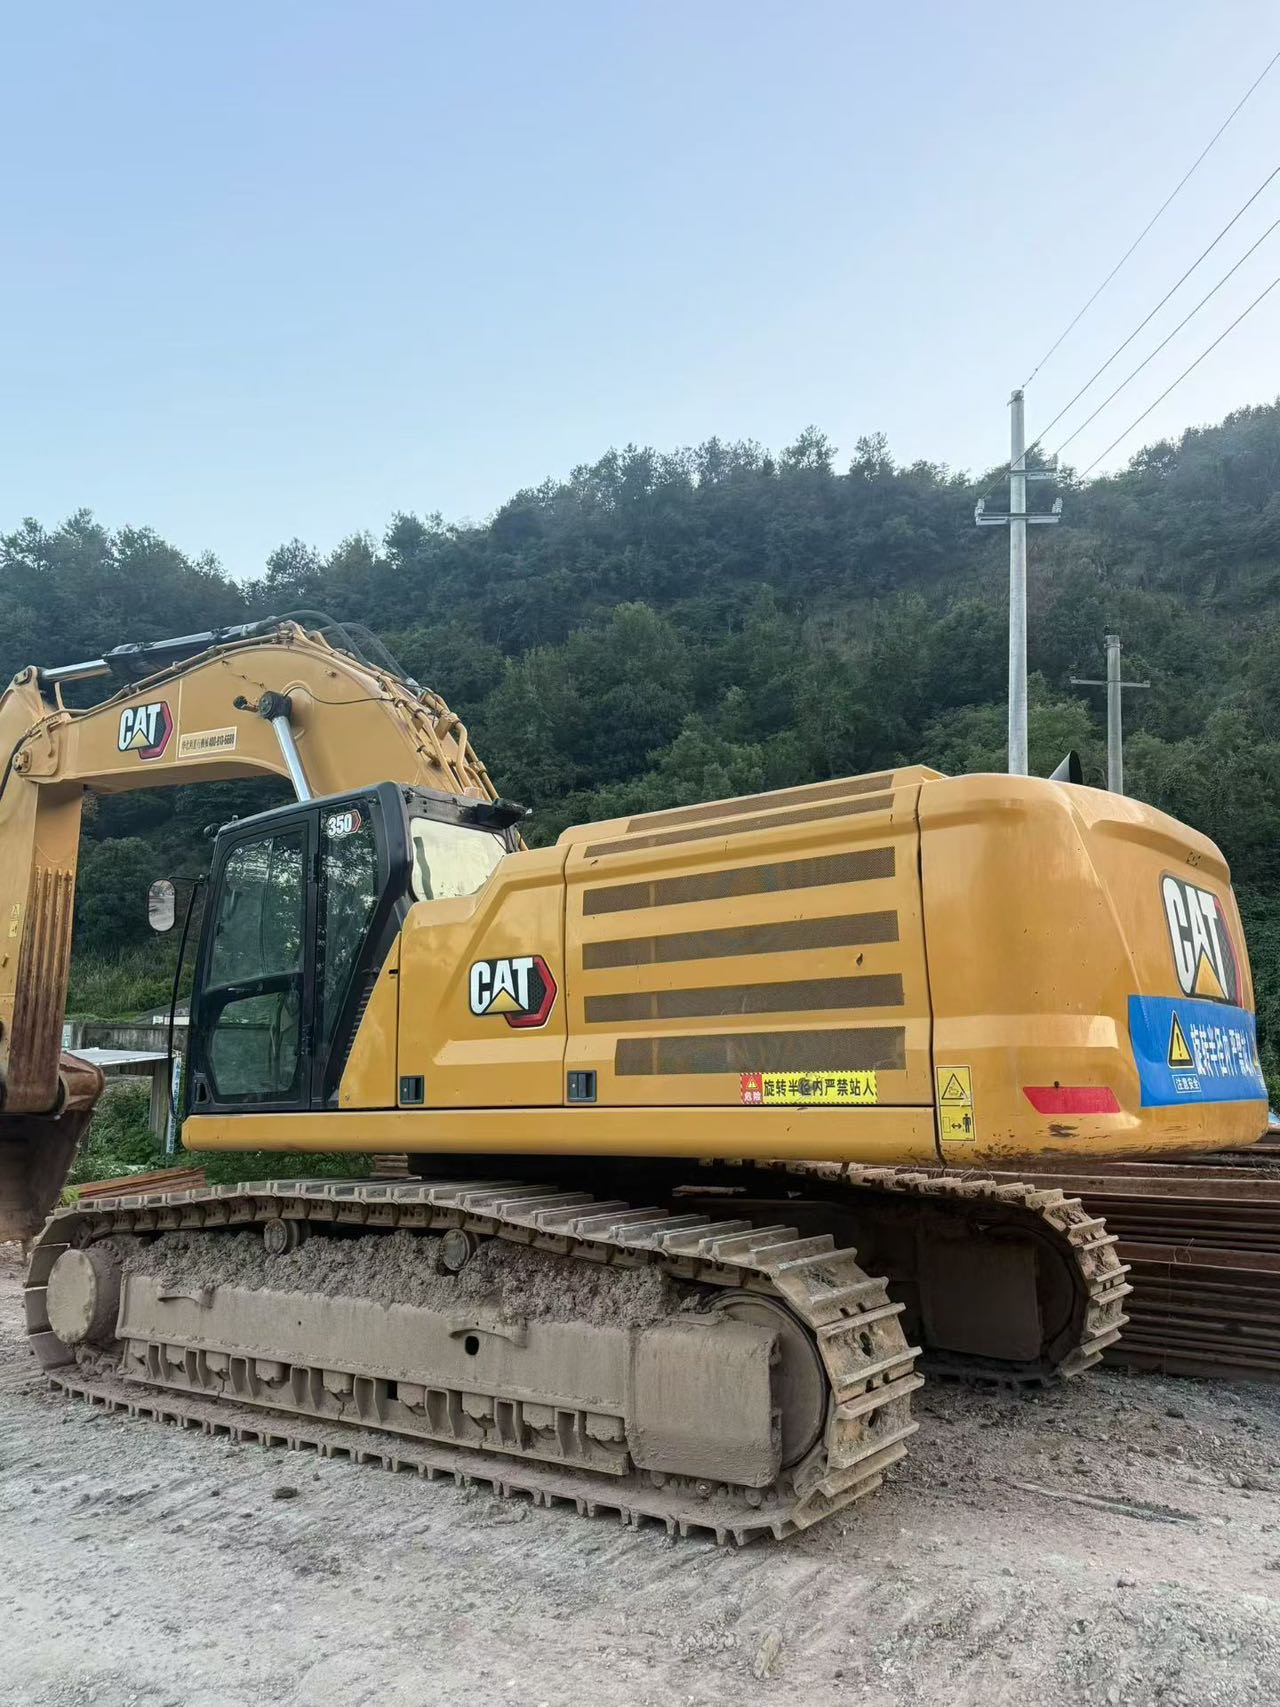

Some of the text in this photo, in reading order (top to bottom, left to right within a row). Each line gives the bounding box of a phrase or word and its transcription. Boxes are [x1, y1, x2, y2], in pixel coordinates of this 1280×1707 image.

[119, 703, 161, 751] CAT
[328, 813, 353, 836] 350
[1163, 877, 1229, 1000] CAT
[470, 957, 533, 1014] CAT
[744, 1091, 761, 1102] 危险
[763, 1078, 875, 1098] 旋转半径内严禁站人
